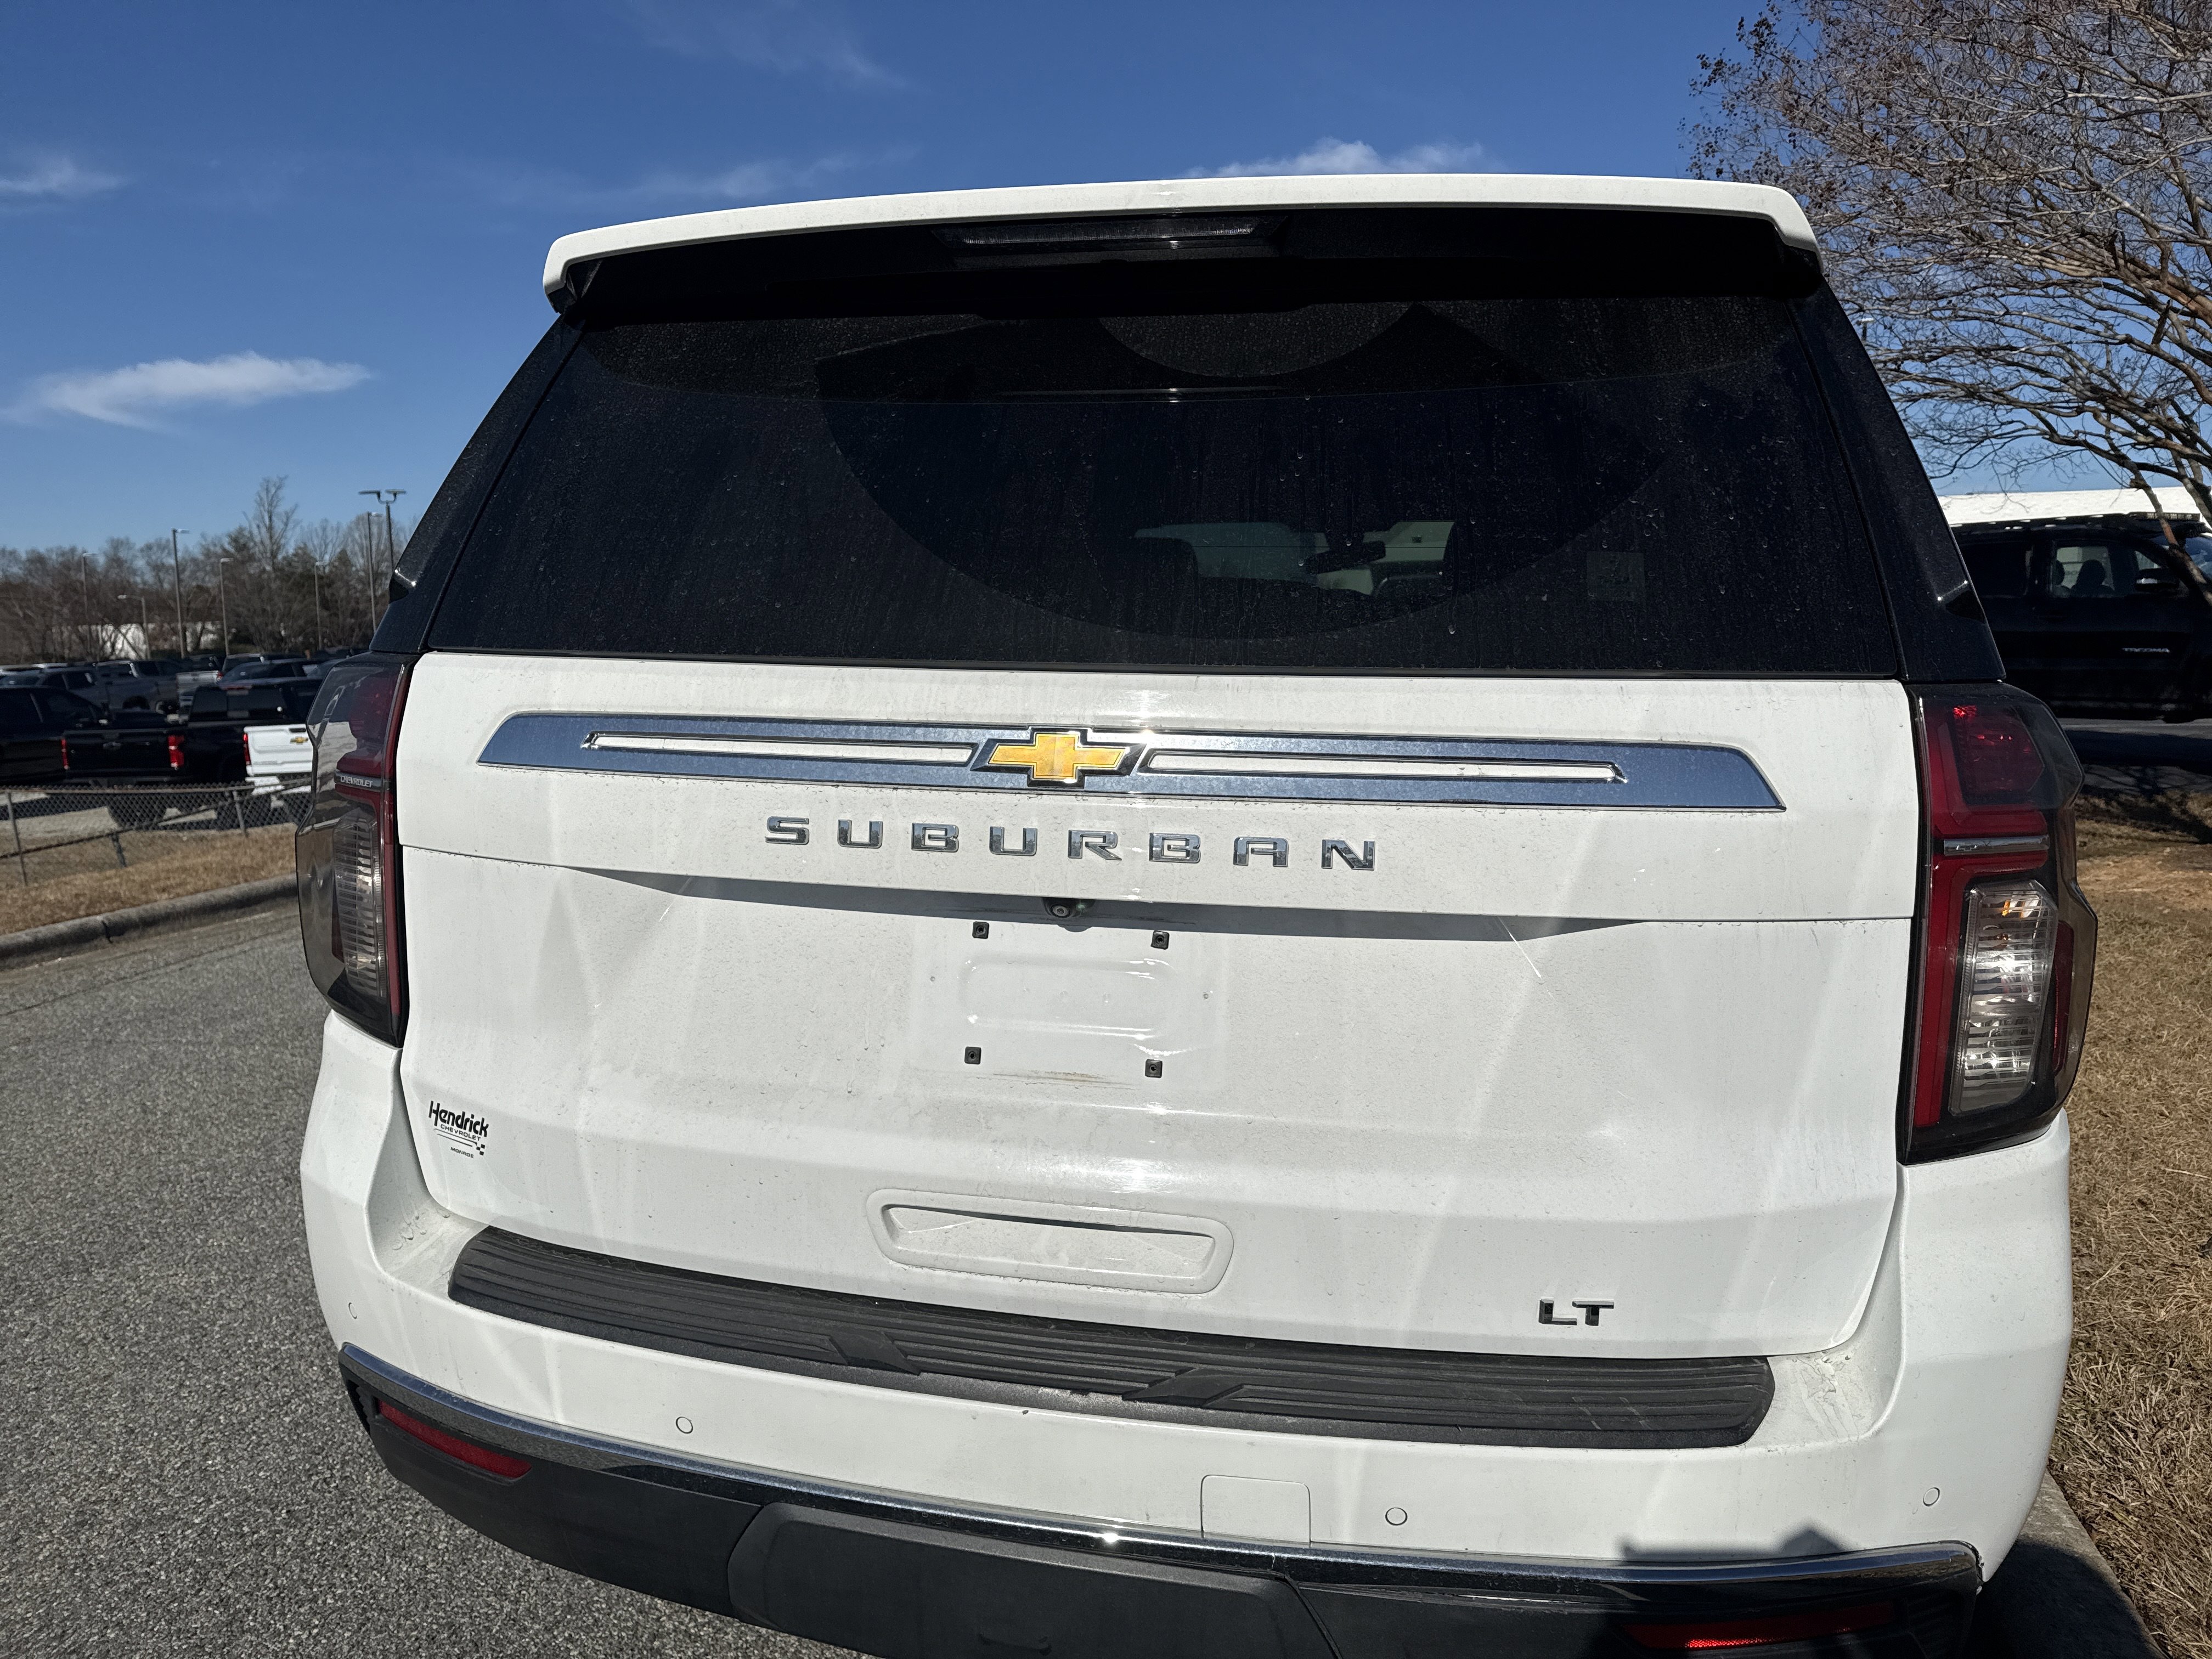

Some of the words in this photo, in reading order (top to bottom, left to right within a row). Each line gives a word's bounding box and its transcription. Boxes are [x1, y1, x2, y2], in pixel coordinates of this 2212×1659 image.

[341, 775, 373, 787] CHEVROLET
[766, 816, 1375, 871] SUBURBAN
[428, 1101, 489, 1137] Hendrick
[441, 1124, 481, 1141] CHEVROLET
[450, 1147, 473, 1158] MONROE
[1538, 1299, 1614, 1326] LT
